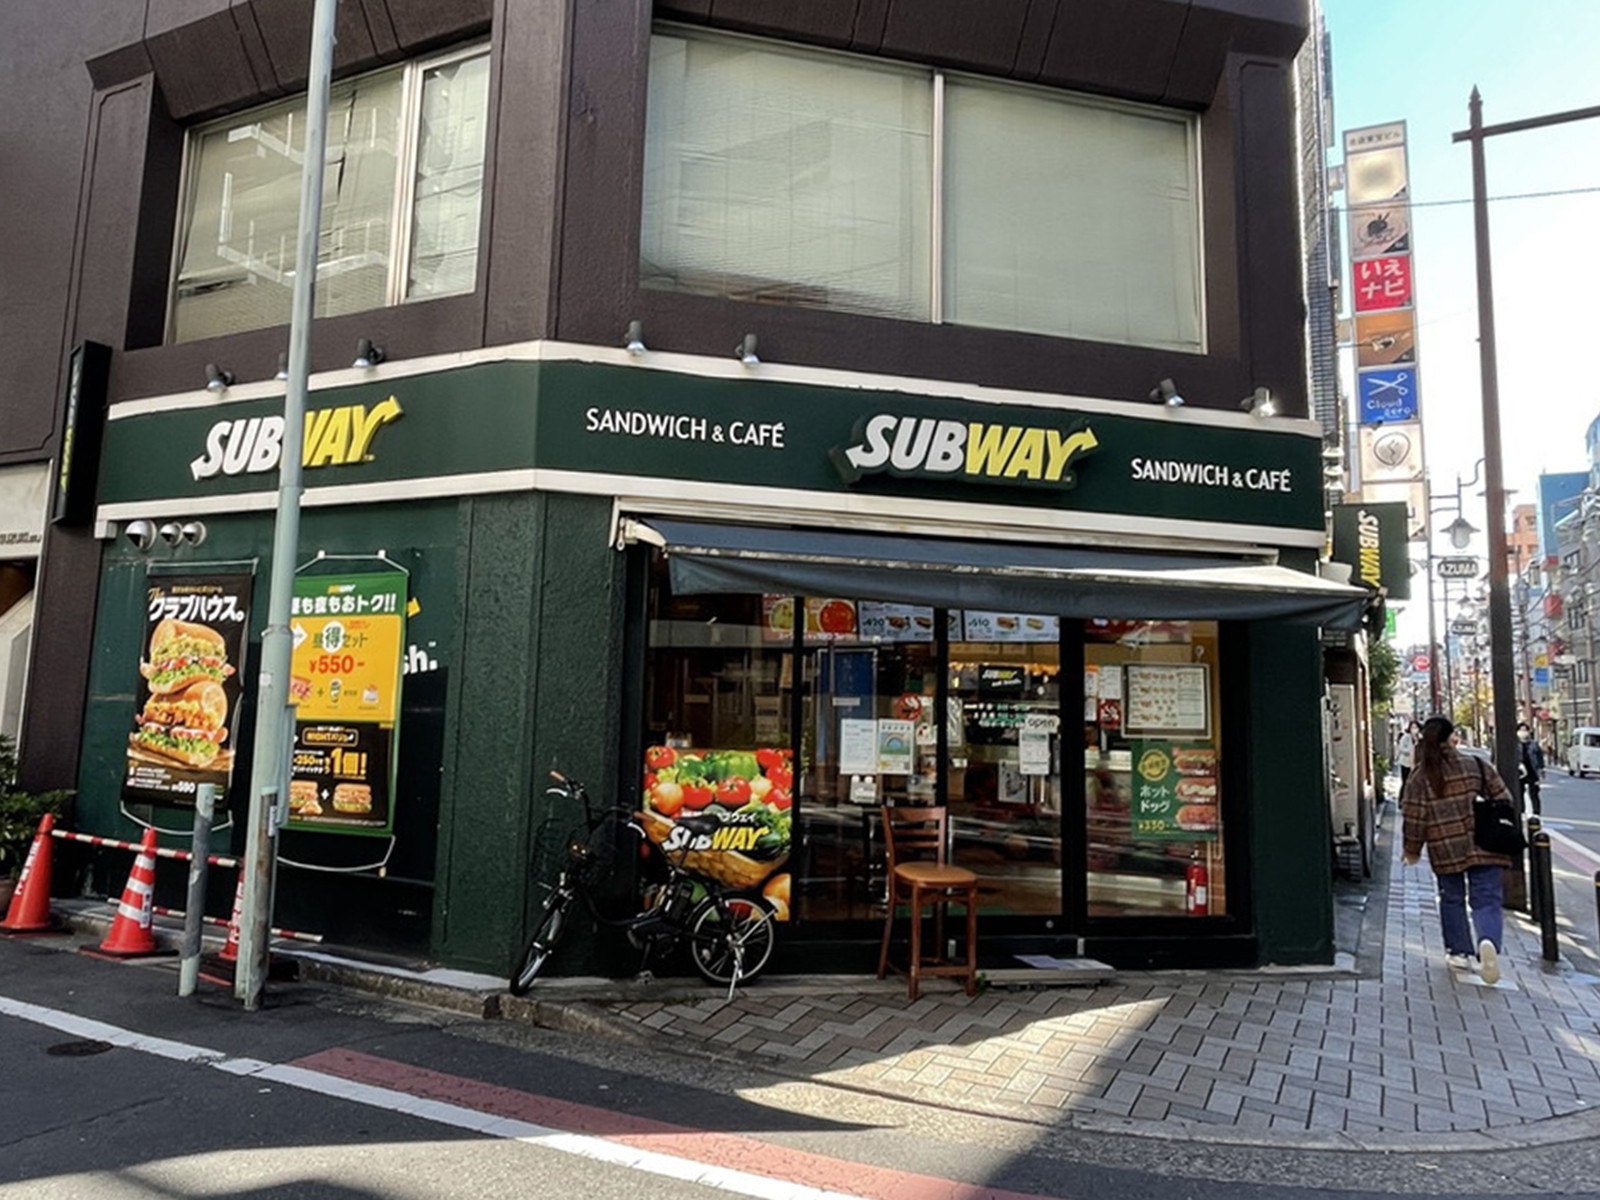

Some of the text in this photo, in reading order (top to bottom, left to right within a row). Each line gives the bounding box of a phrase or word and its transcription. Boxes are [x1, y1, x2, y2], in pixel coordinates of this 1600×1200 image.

[1361, 259, 1404, 279] いえ
[1361, 278, 1405, 299] ナビ
[586, 408, 785, 447] SANDWICH & CAFÉ
[845, 414, 1098, 481] SUBWAY
[1131, 458, 1292, 492] SANDWICH & CAFÉ
[1358, 510, 1382, 588] SUBWAY
[1440, 563, 1477, 576] AZUMA
[1028, 718, 1055, 729] open
[1140, 785, 1170, 799] ホット
